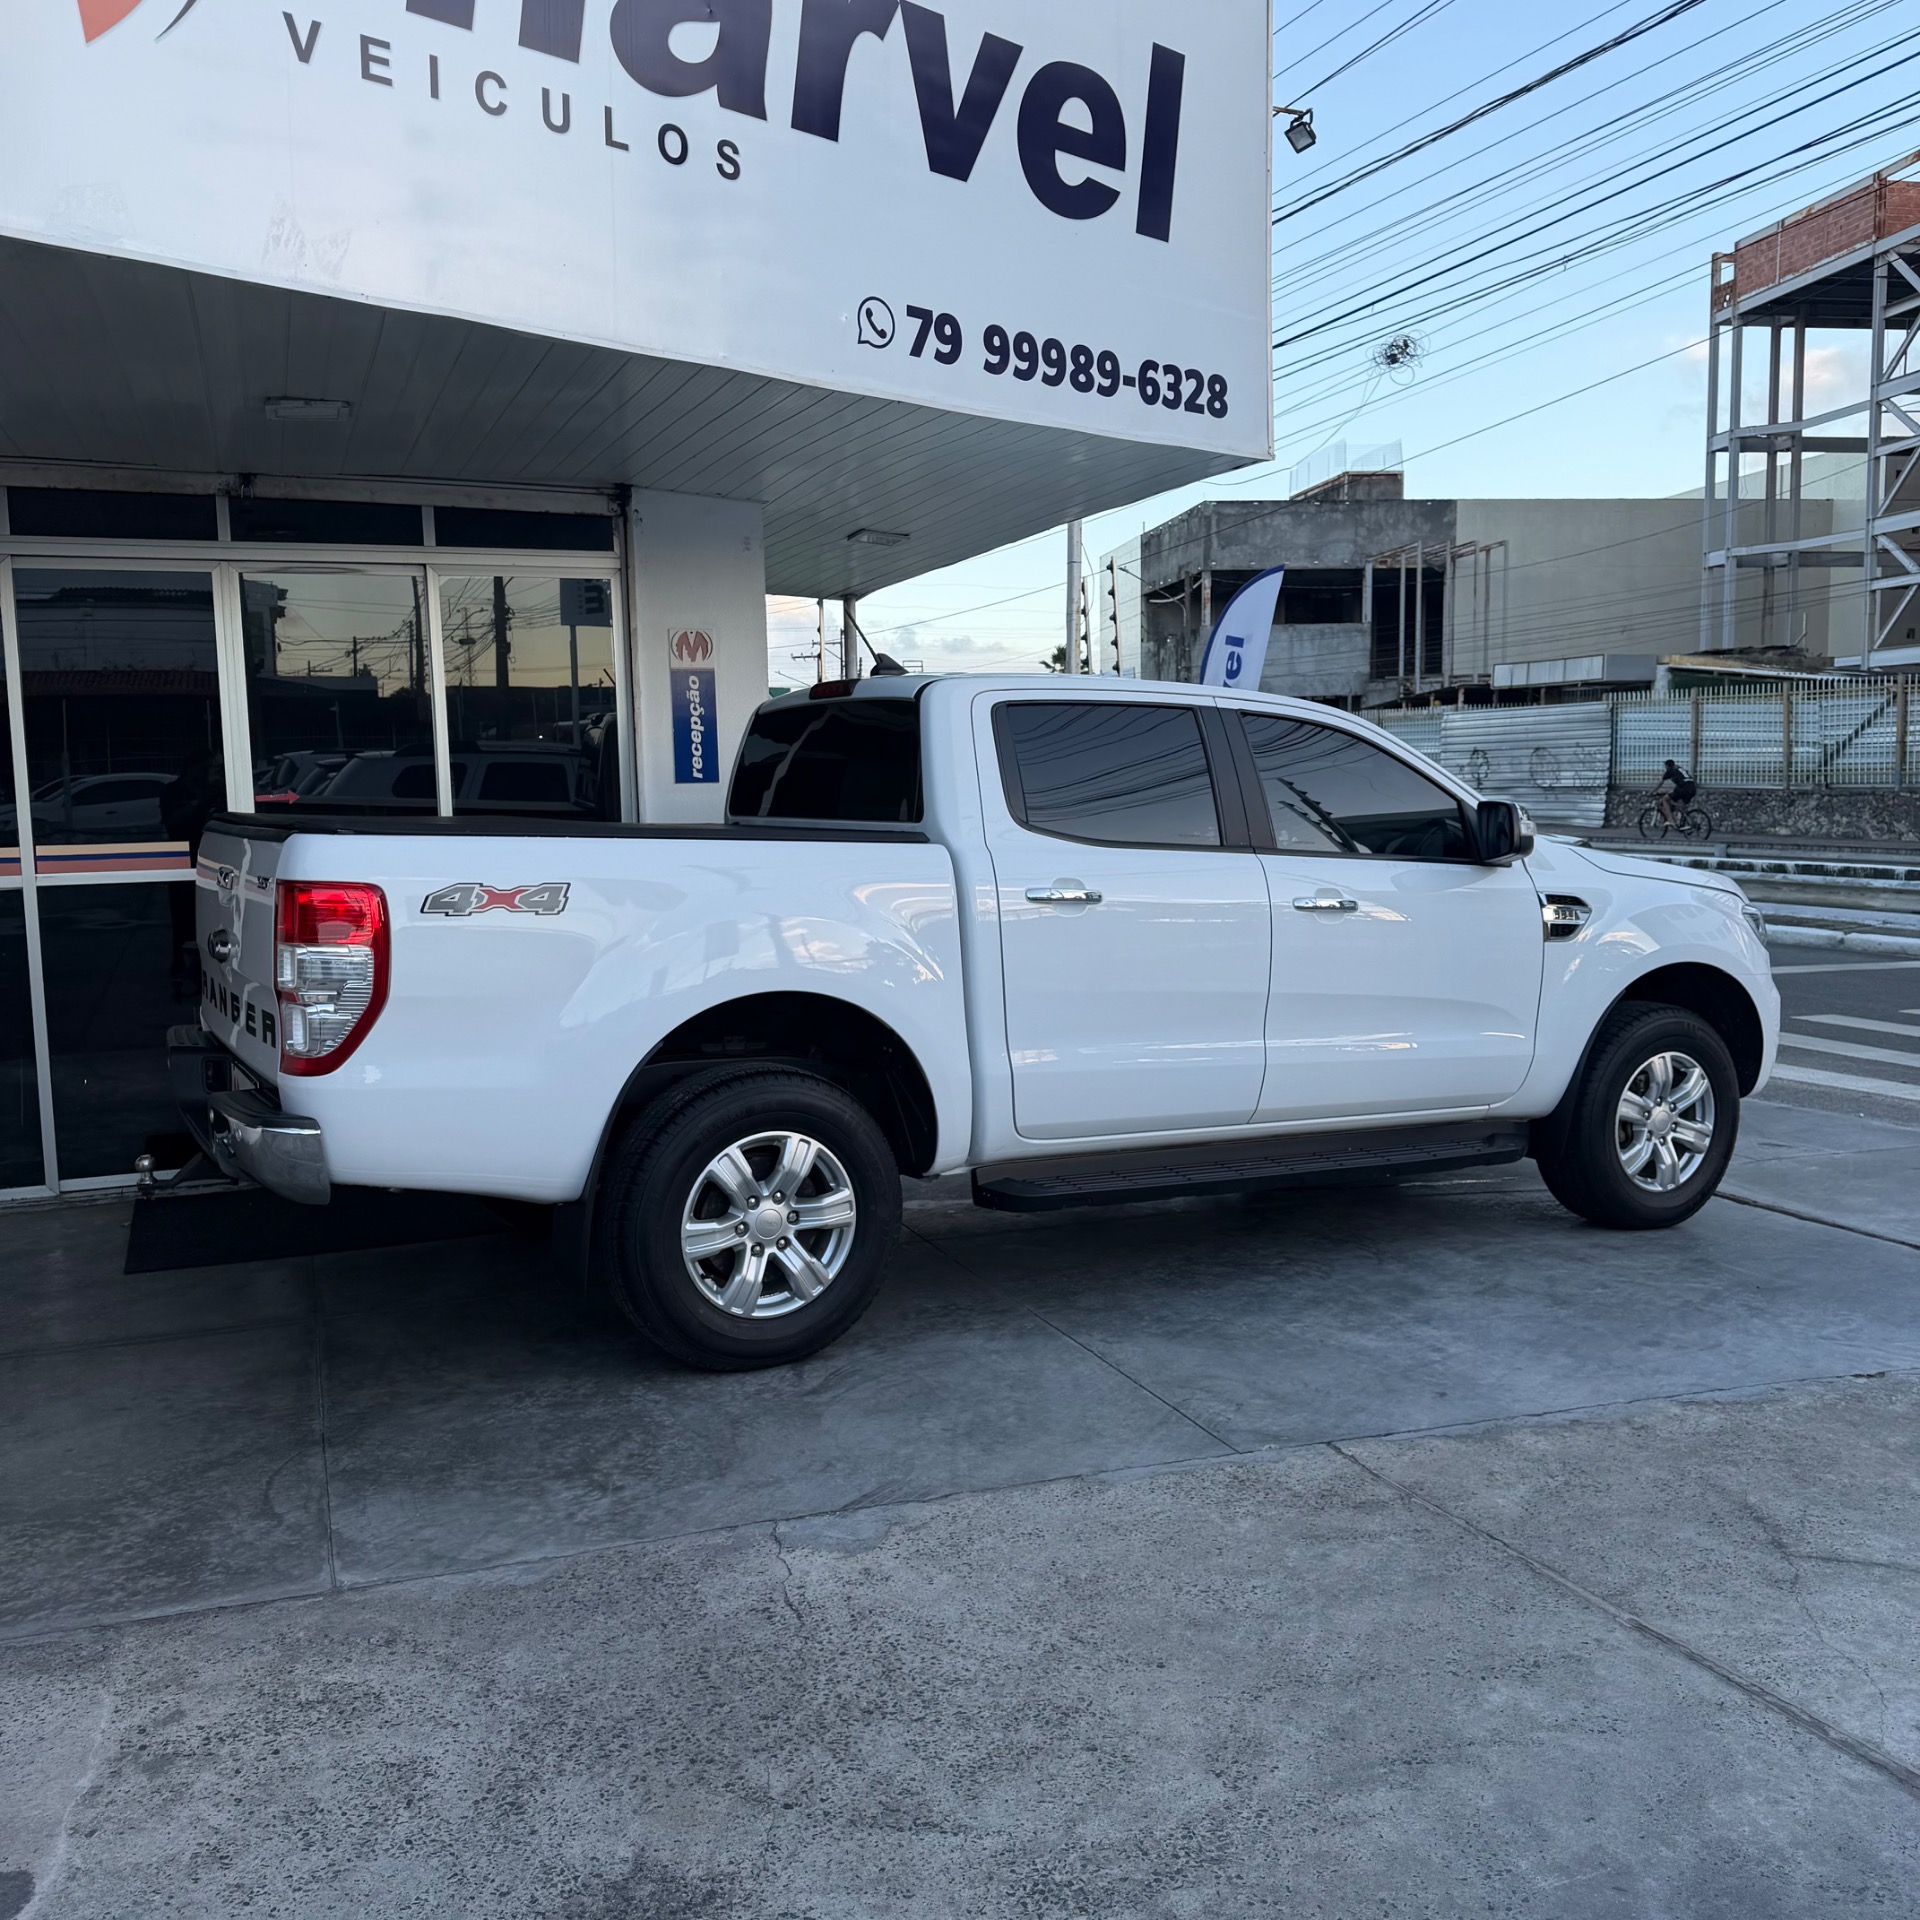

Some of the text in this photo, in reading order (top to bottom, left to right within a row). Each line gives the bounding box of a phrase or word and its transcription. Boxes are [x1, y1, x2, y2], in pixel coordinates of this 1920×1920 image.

[282, 11, 742, 181] VEICULOS
[405, 0, 1186, 243] arvel
[906, 305, 1229, 419] 79 99989-6328
[1223, 634, 1245, 688] el
[686, 675, 705, 779] recepção
[202, 969, 277, 1049] RANGER
